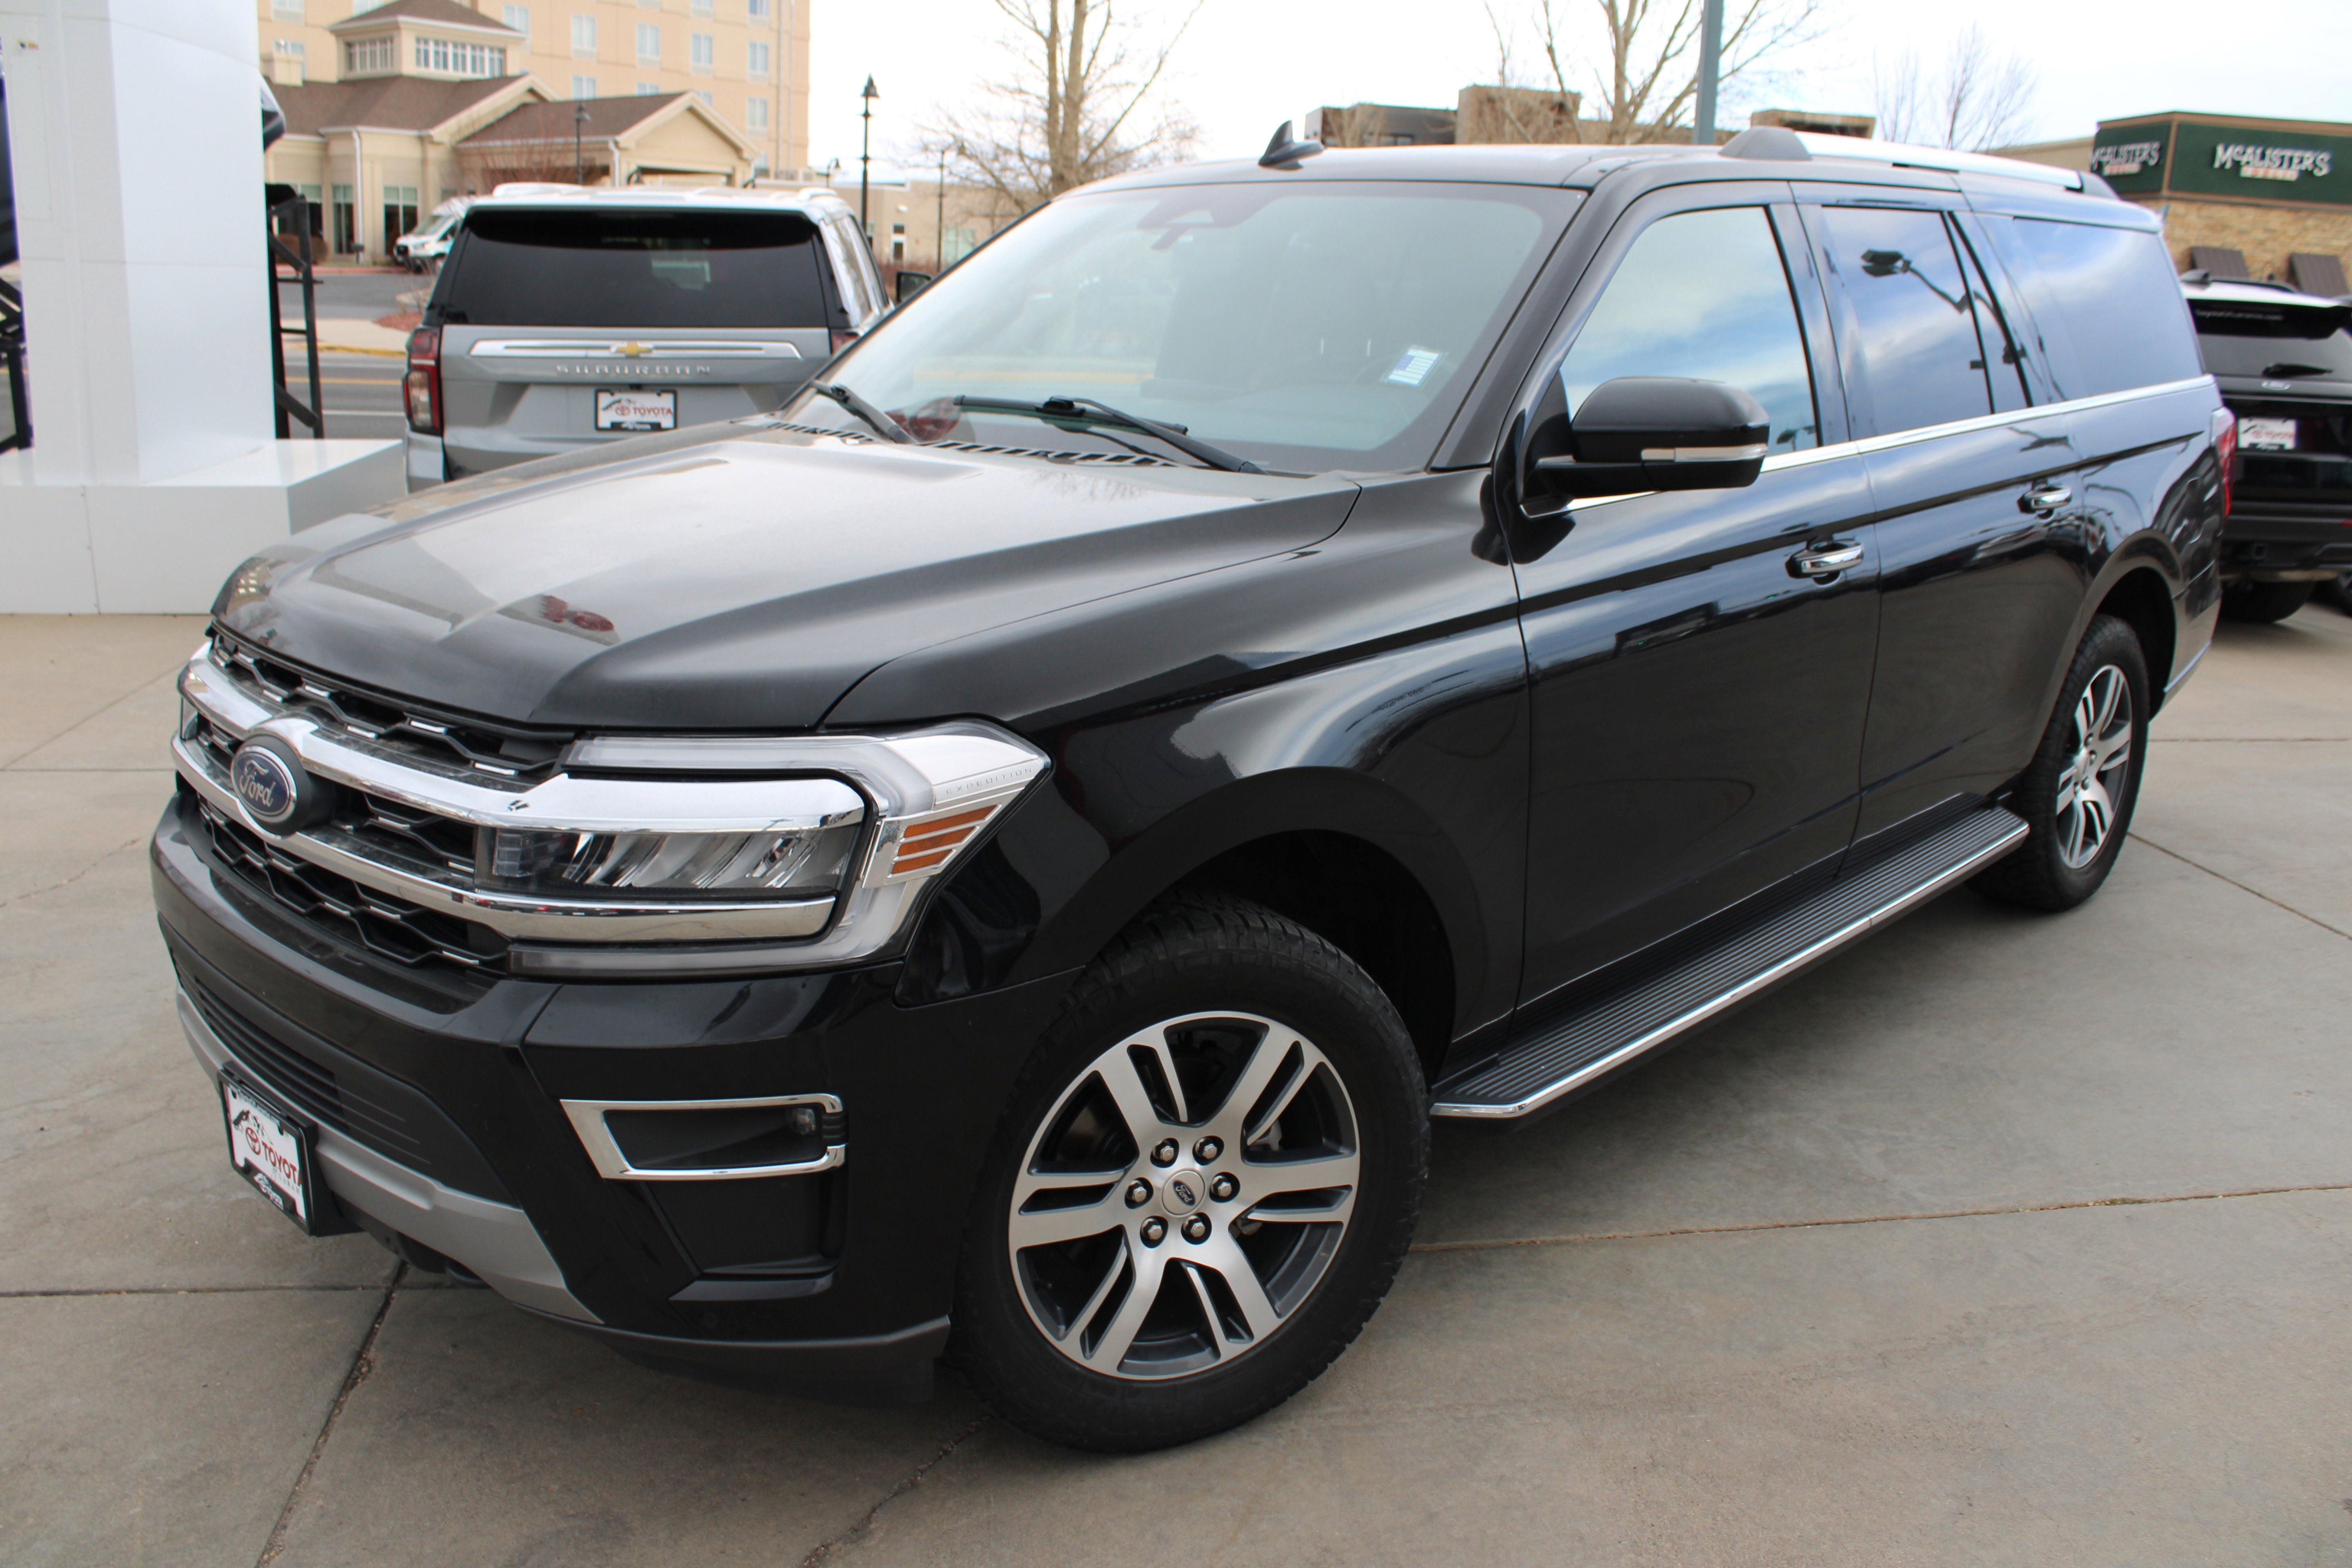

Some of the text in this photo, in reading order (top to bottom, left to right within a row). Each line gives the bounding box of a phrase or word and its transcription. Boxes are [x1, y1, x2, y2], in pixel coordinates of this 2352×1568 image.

[633, 406, 673, 416] TOYOTA
[238, 760, 276, 807] Ford
[946, 767, 1032, 795] EXPEDITION
[1175, 1185, 1193, 1203] Ford
